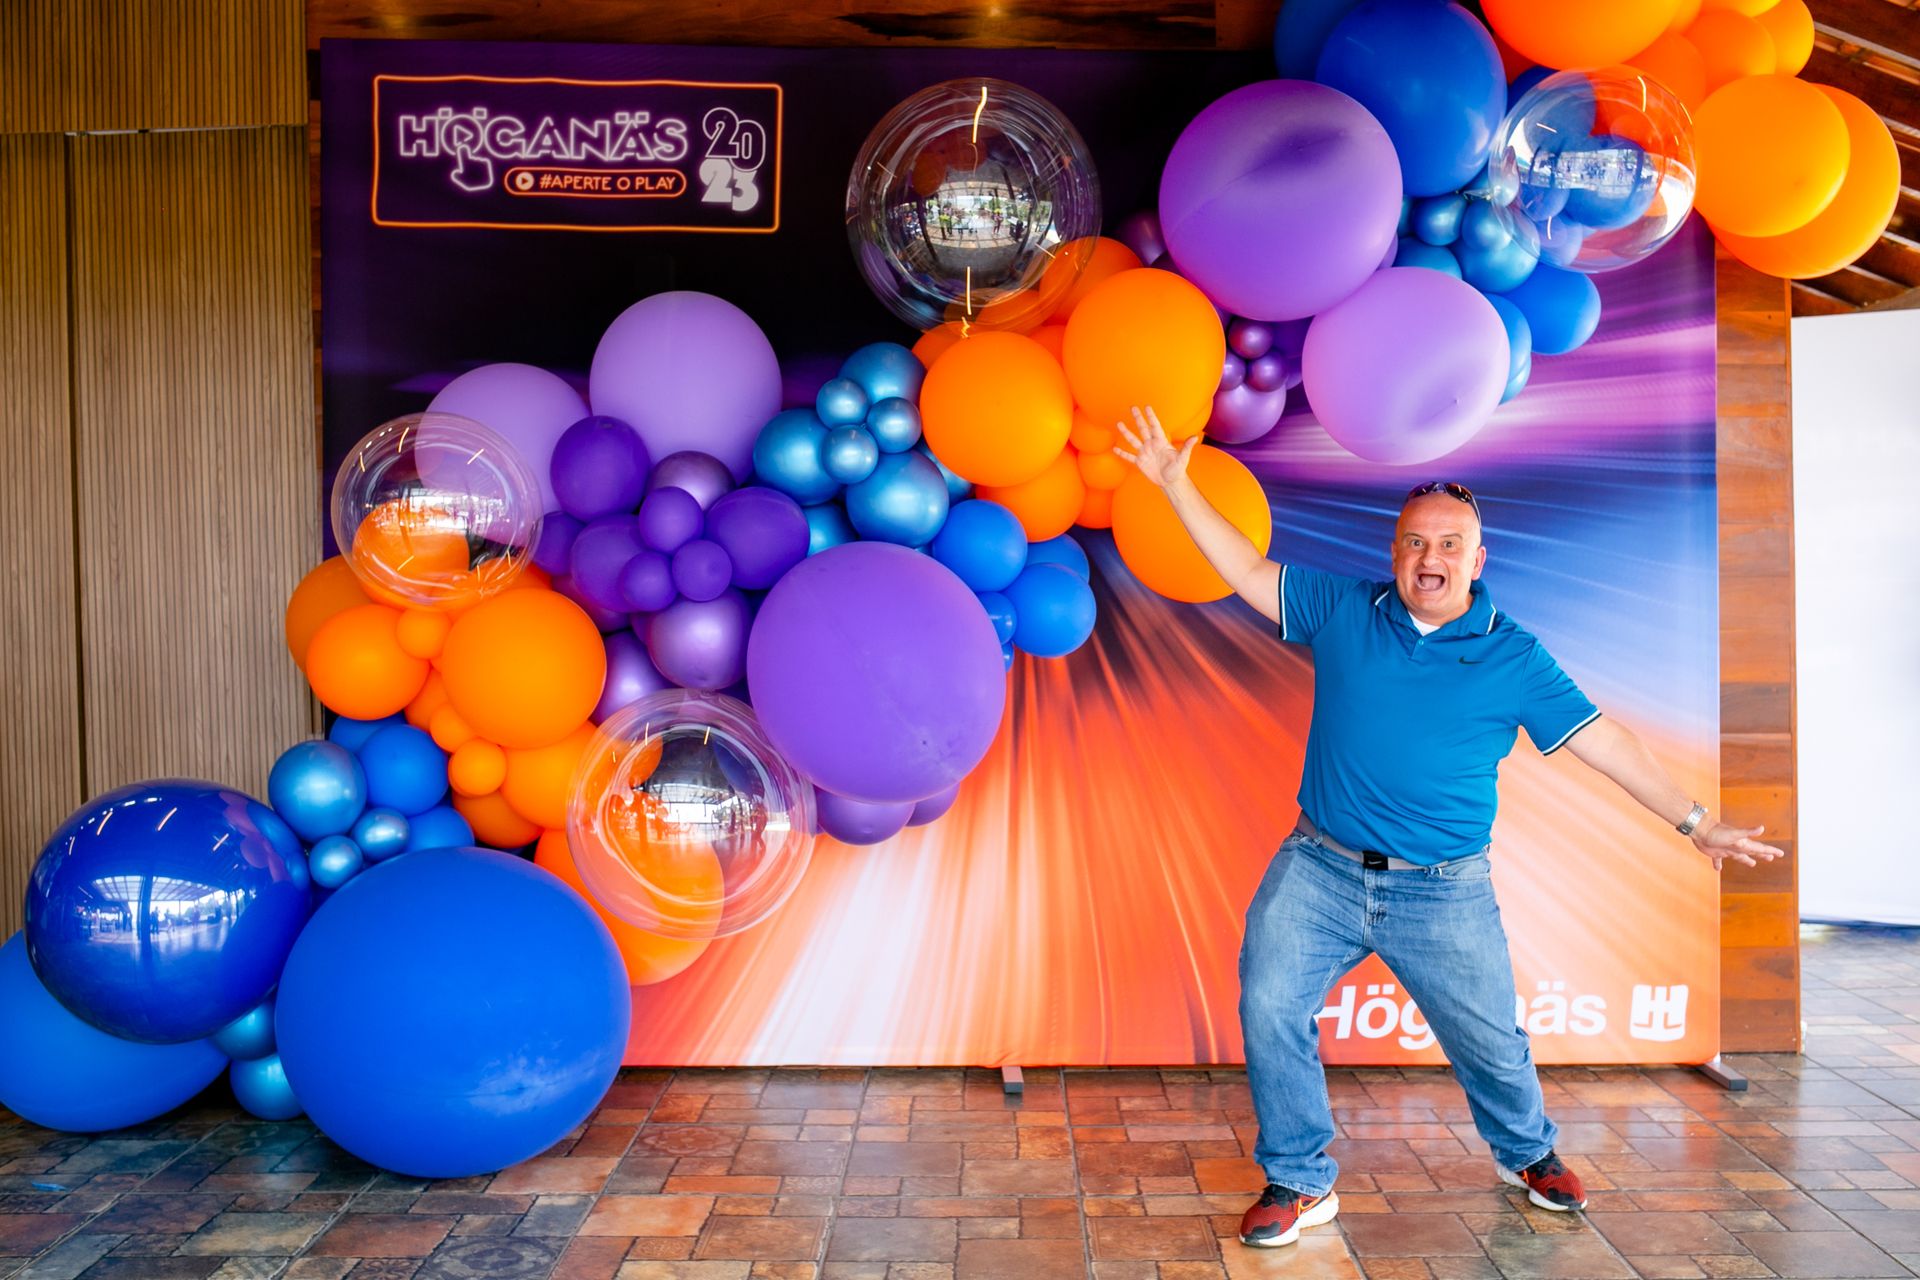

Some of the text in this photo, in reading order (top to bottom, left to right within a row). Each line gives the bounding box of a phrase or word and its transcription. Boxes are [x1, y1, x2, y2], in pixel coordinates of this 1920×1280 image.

[399, 107, 688, 161] HÖGANÄS
[540, 174, 676, 191] #APERTE O PLAY
[1313, 981, 1607, 1050] Högäs
